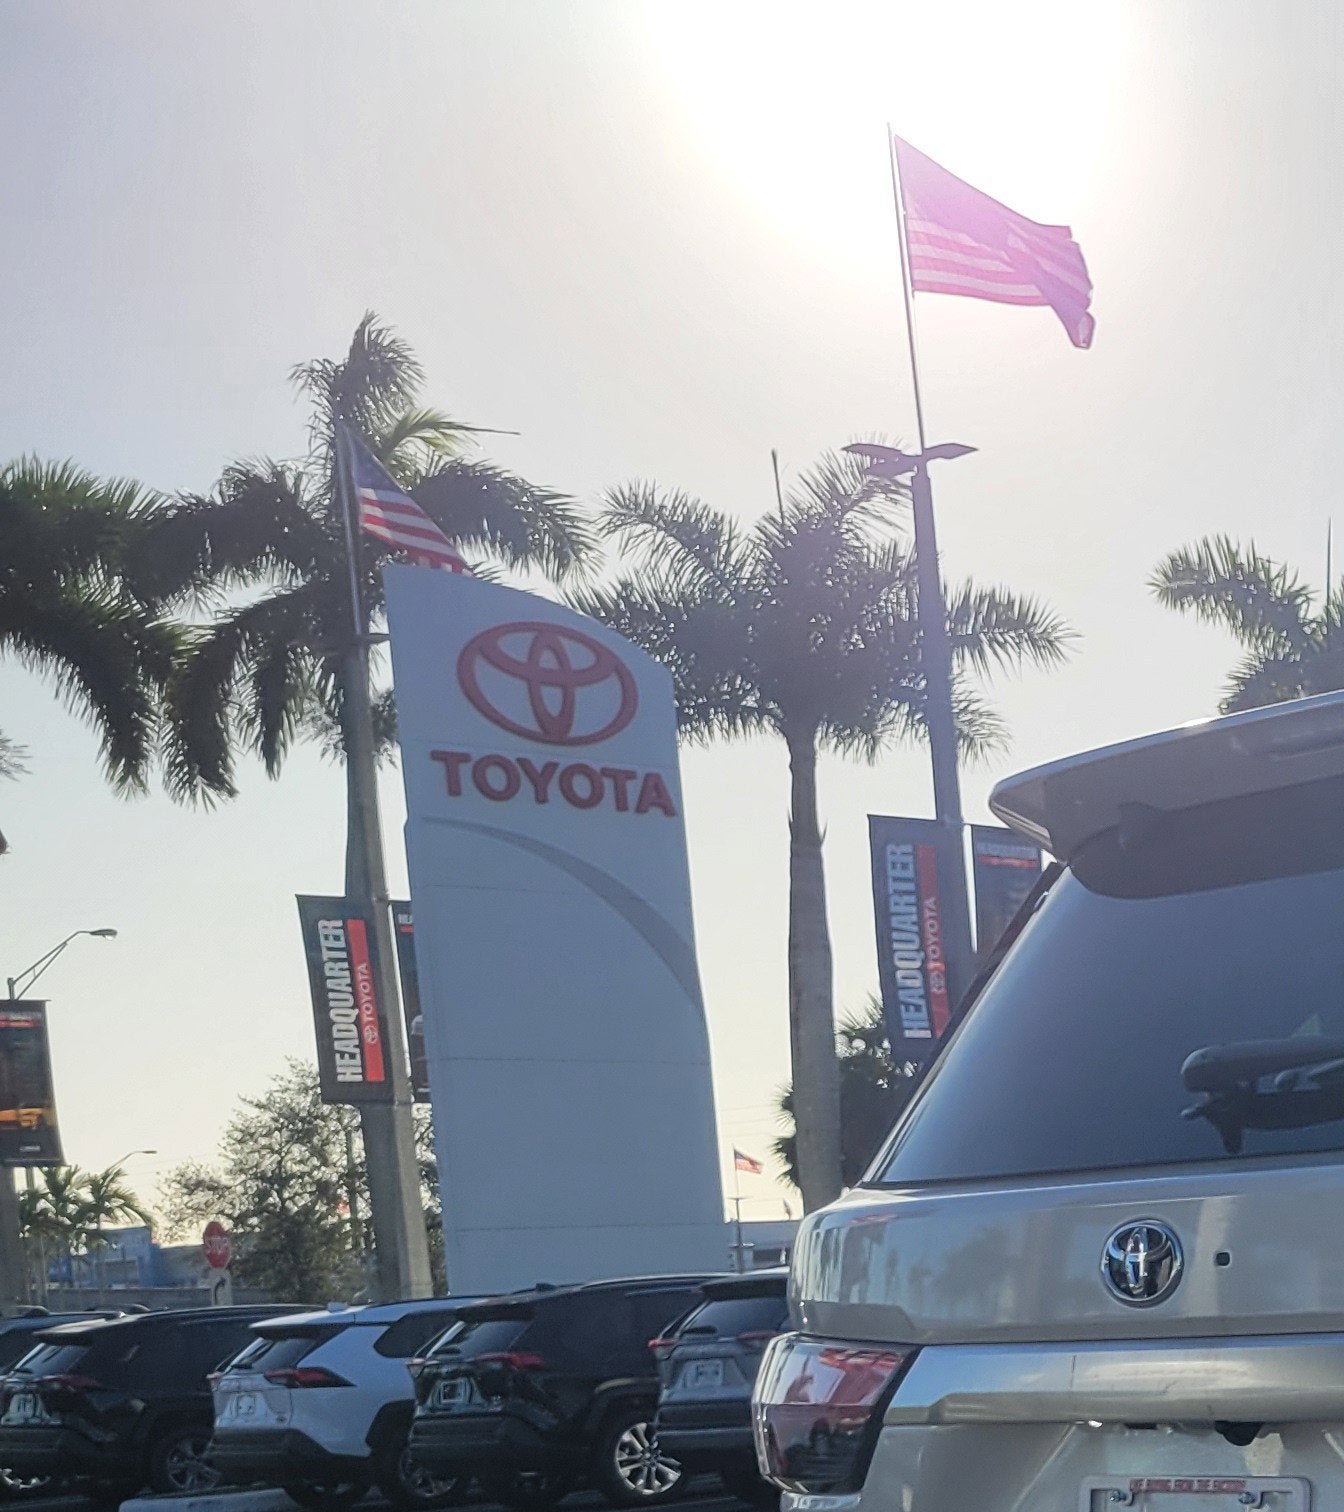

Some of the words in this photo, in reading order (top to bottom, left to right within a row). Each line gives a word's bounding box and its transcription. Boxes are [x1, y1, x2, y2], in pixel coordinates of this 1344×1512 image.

[429, 749, 678, 818] TOYOTA
[357, 962, 376, 1022] TOYOTA
[886, 843, 932, 1039] HEADQUARTER
[317, 919, 364, 1083] HEADQUARTER
